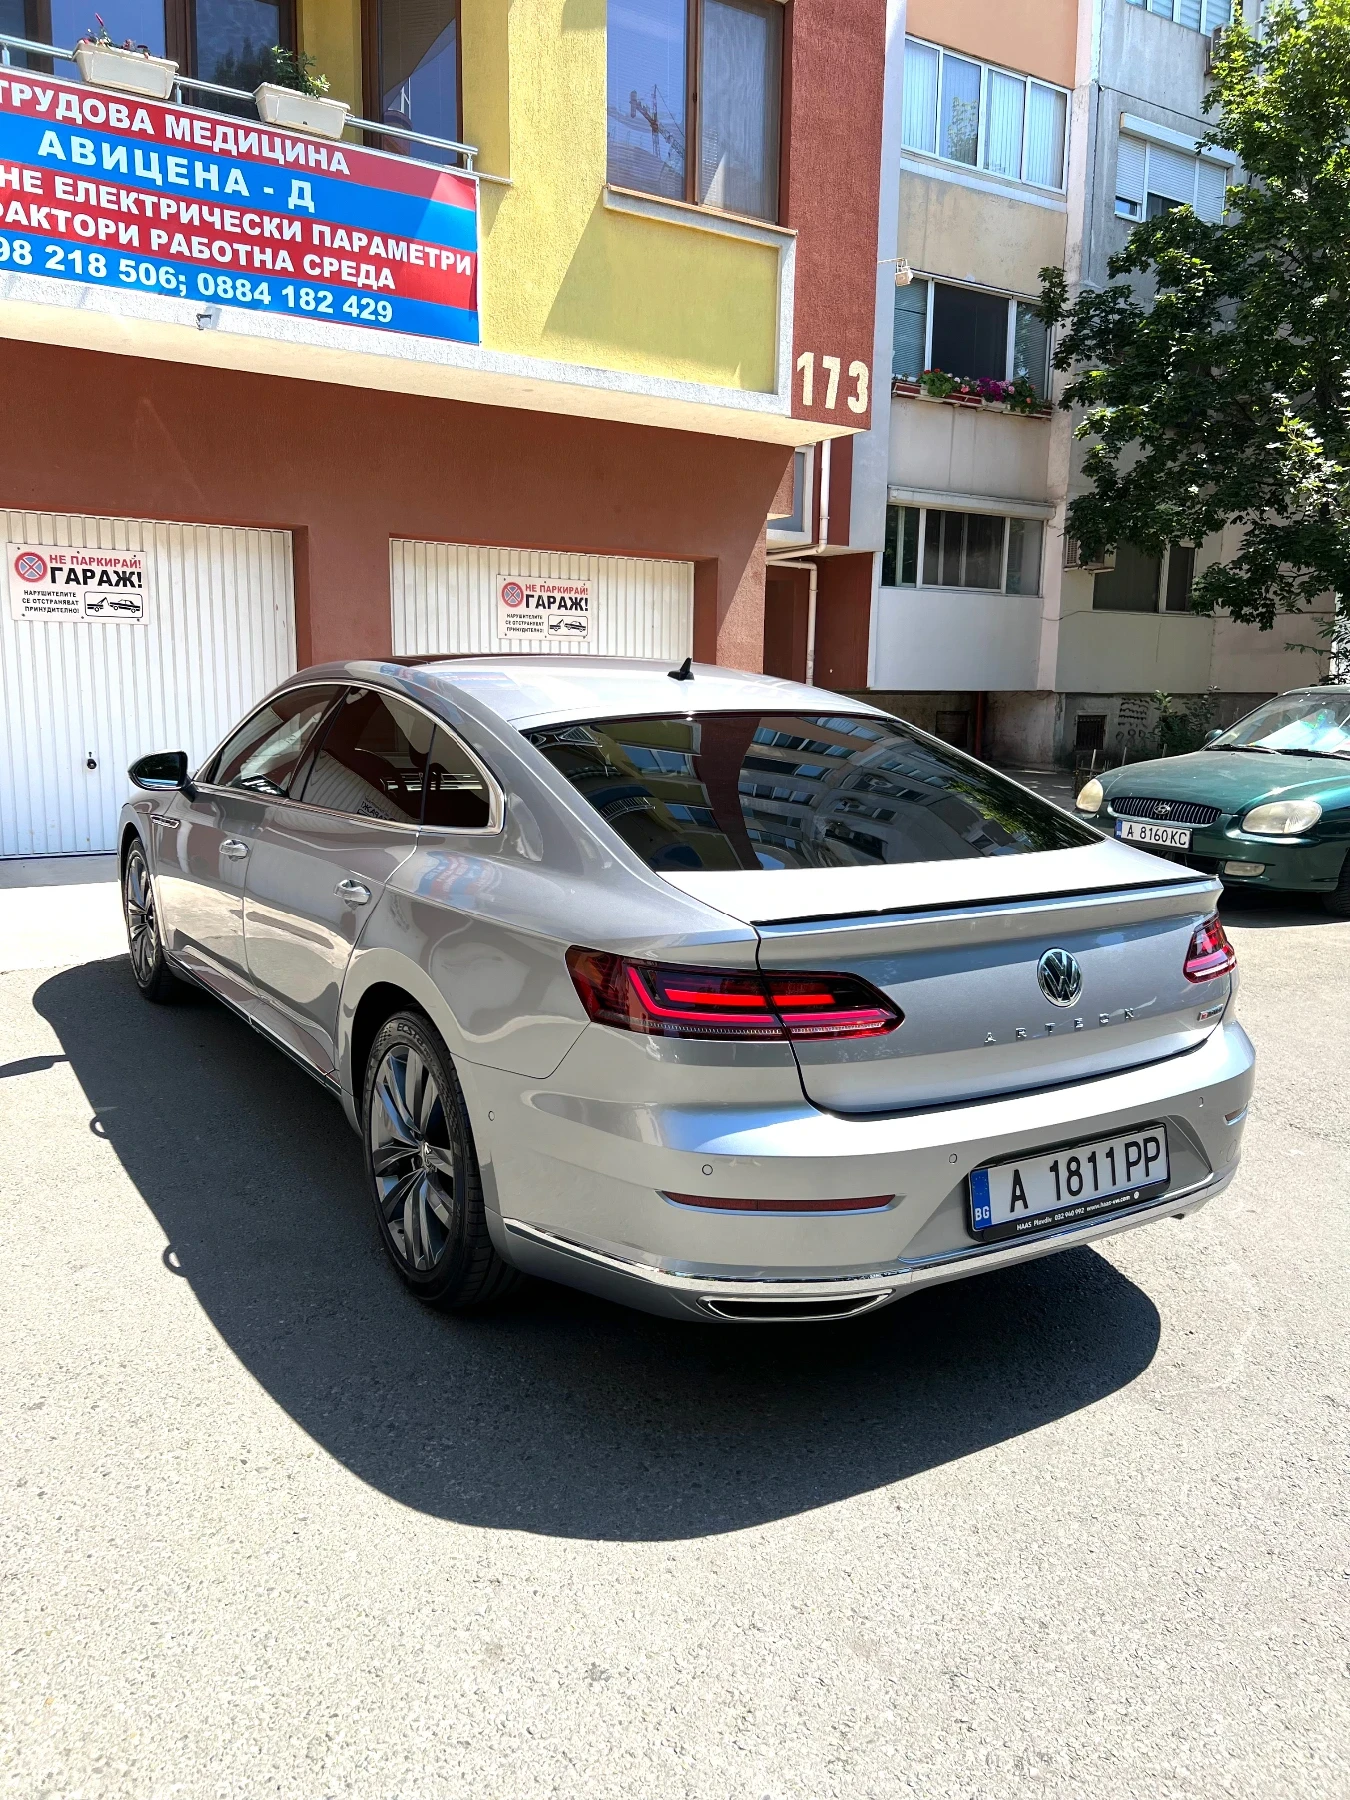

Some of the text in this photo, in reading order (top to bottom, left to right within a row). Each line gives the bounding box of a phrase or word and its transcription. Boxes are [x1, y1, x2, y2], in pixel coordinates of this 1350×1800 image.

[164, 114, 351, 175] МЕДИЦИНА
[38, 130, 250, 197] АВИЦЕНА
[288, 178, 315, 213] Д
[54, 175, 302, 243] ЕЛЕКТРИЧЕСКИ
[312, 224, 472, 276] ПАРАМЕТРИ
[0, 200, 396, 291] АКТОРИ РАБОТНА СРЕДА
[45, 244, 107, 278] 218
[118, 259, 188, 298] 506;
[197, 271, 272, 306] 0884
[281, 285, 334, 315] 182
[342, 294, 393, 324] 429
[796, 351, 869, 414] 173
[49, 554, 142, 569] НЕ ПАРКИРАЙ!
[49, 566, 143, 589] ГАРАЖ!
[23, 589, 77, 598] НАРУШИТЕЛИТЕ
[525, 584, 589, 596] НЕ ПАРКИРАЙ!
[32, 598, 79, 606] ОТСТРАНЯВАТ
[525, 593, 589, 612] ГАРАЖ!
[1127, 824, 1187, 846] A 8160KC
[974, 1136, 1161, 1221] BG A 1811PP
[1016, 1221, 1032, 1231] HAAS
